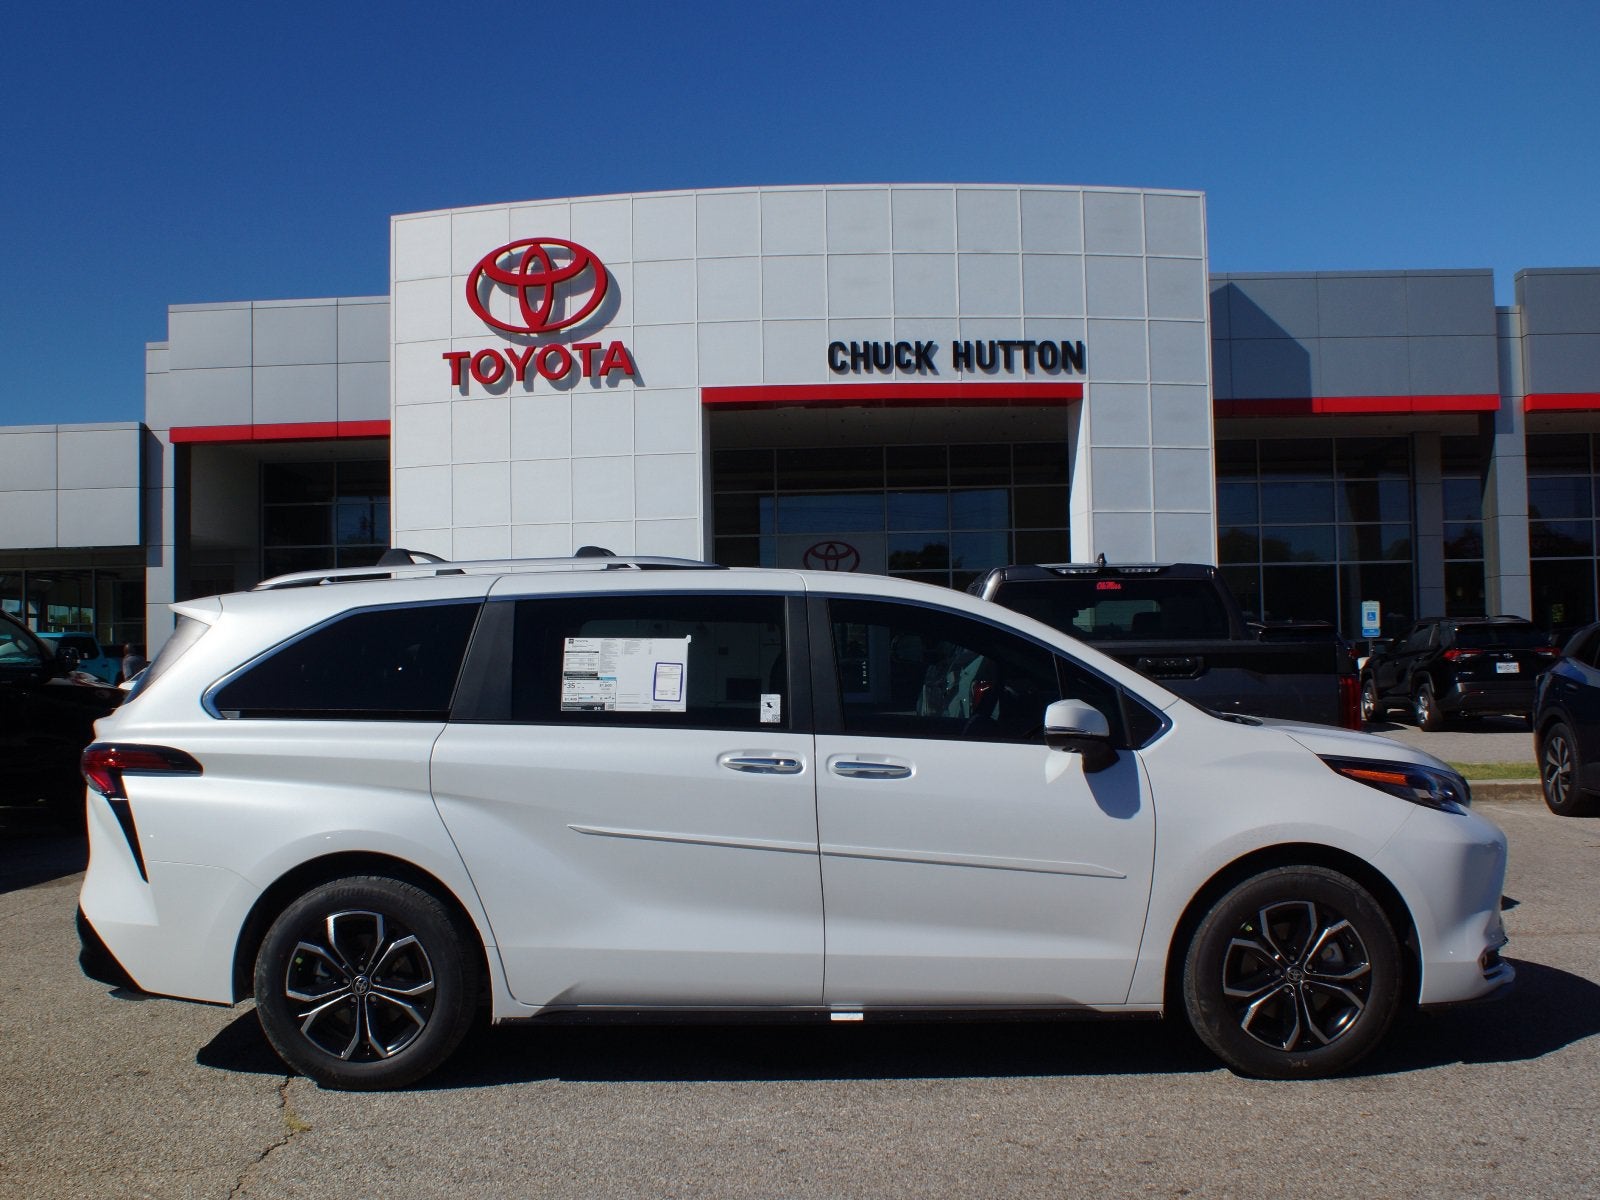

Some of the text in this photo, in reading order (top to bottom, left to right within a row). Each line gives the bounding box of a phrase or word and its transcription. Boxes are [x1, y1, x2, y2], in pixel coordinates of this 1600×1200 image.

[442, 340, 635, 386] TOYOTA
[828, 340, 1084, 371] CHUCK HUTTON
